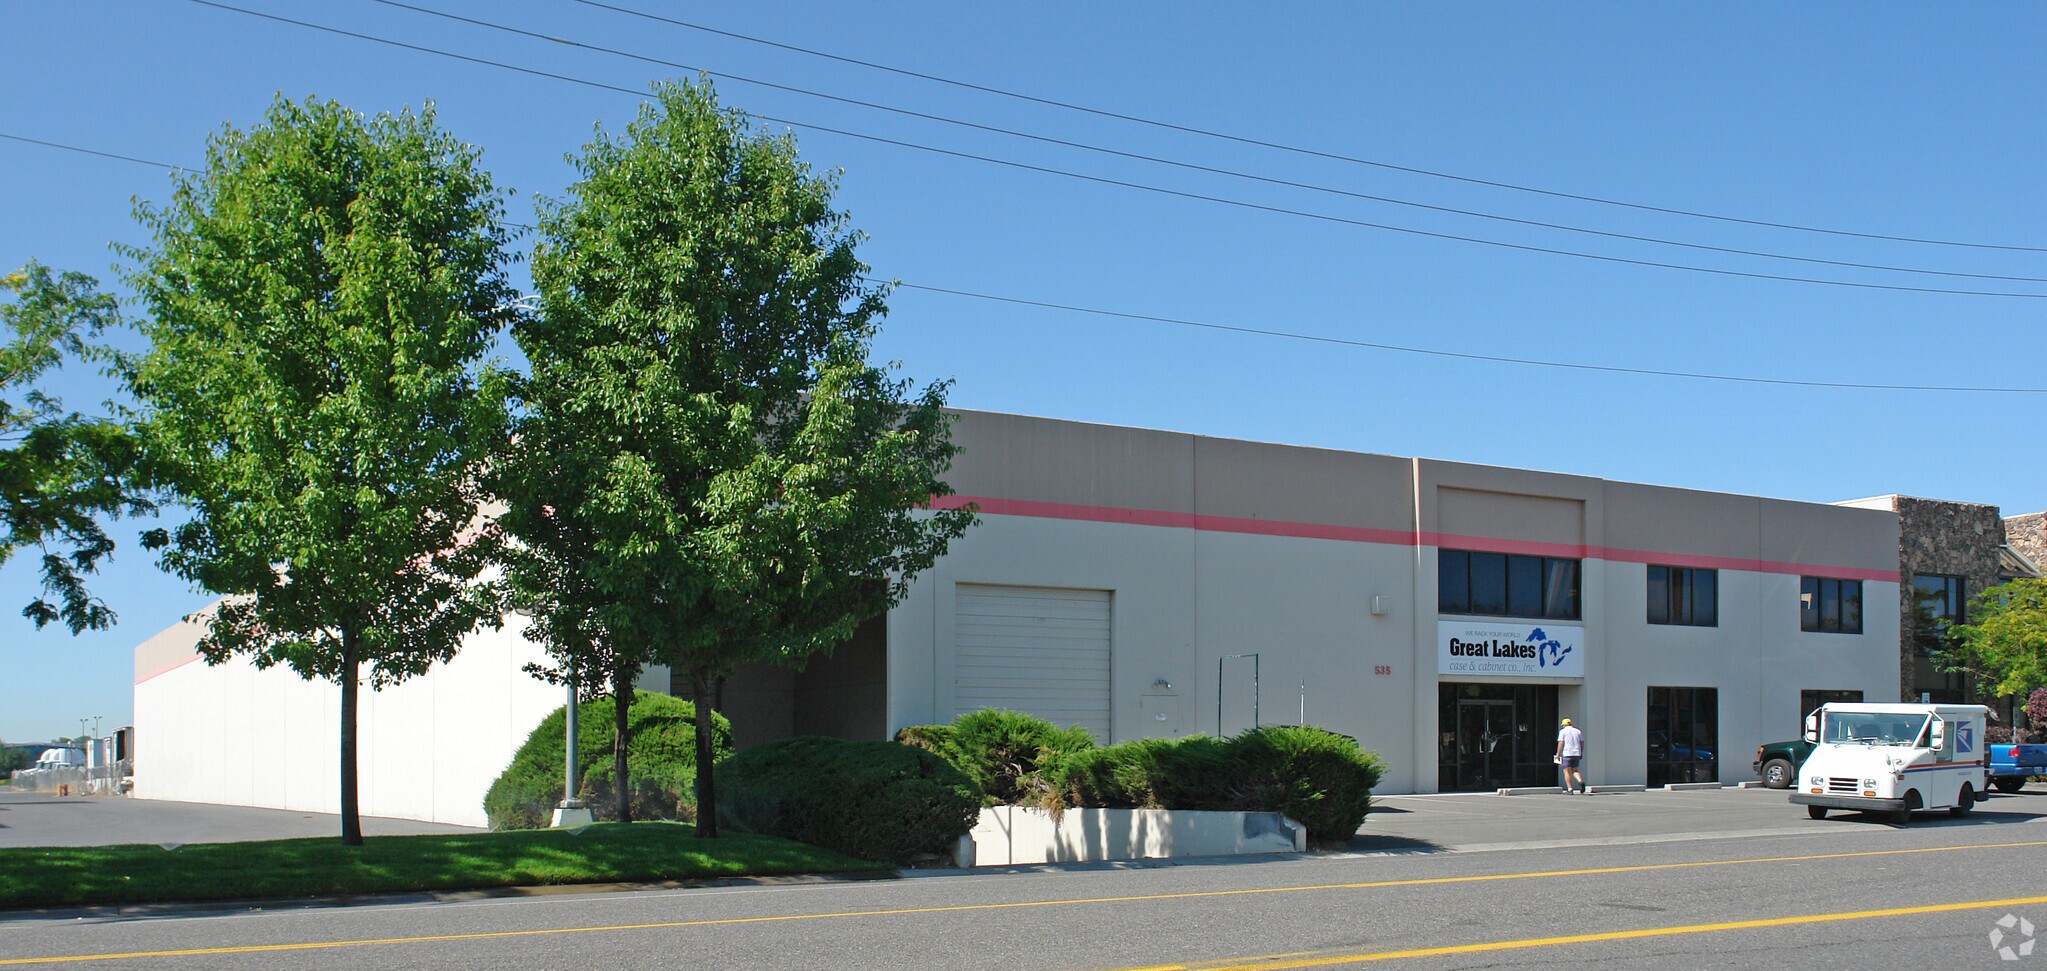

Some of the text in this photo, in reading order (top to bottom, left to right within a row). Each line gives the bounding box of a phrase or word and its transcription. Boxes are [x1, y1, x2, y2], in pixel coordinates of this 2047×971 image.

[1450, 638, 1536, 659] Great Lakes
[1374, 665, 1391, 675] 535
[1449, 662, 1537, 673] case & cabinet co., Inc.
